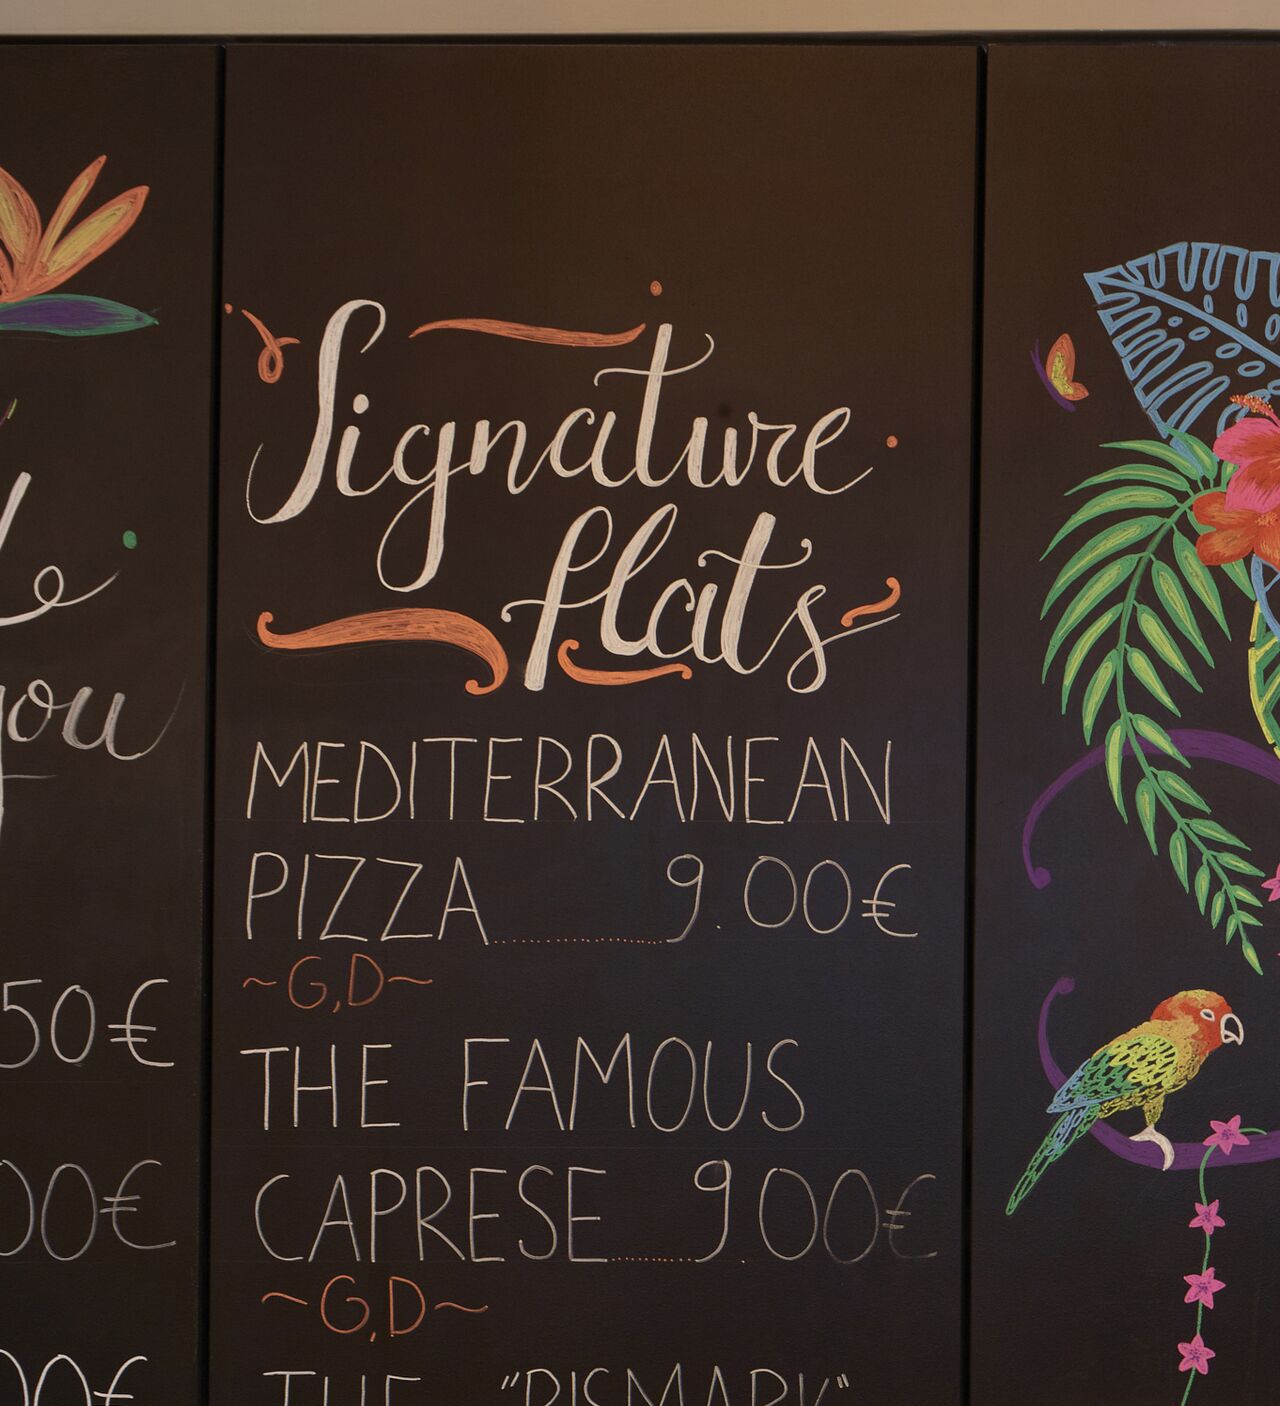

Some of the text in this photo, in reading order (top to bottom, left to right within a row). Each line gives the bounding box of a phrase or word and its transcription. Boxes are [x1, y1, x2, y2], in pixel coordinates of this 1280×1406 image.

[247, 299, 874, 591] Signature
[0, 678, 185, 761] ou
[247, 734, 891, 825] MEDITERRANEAN
[247, 851, 917, 945] PIZZA 9.00€
[241, 1033, 805, 1131] THE FAMOUS
[256, 1165, 608, 1263] CAPRESE
